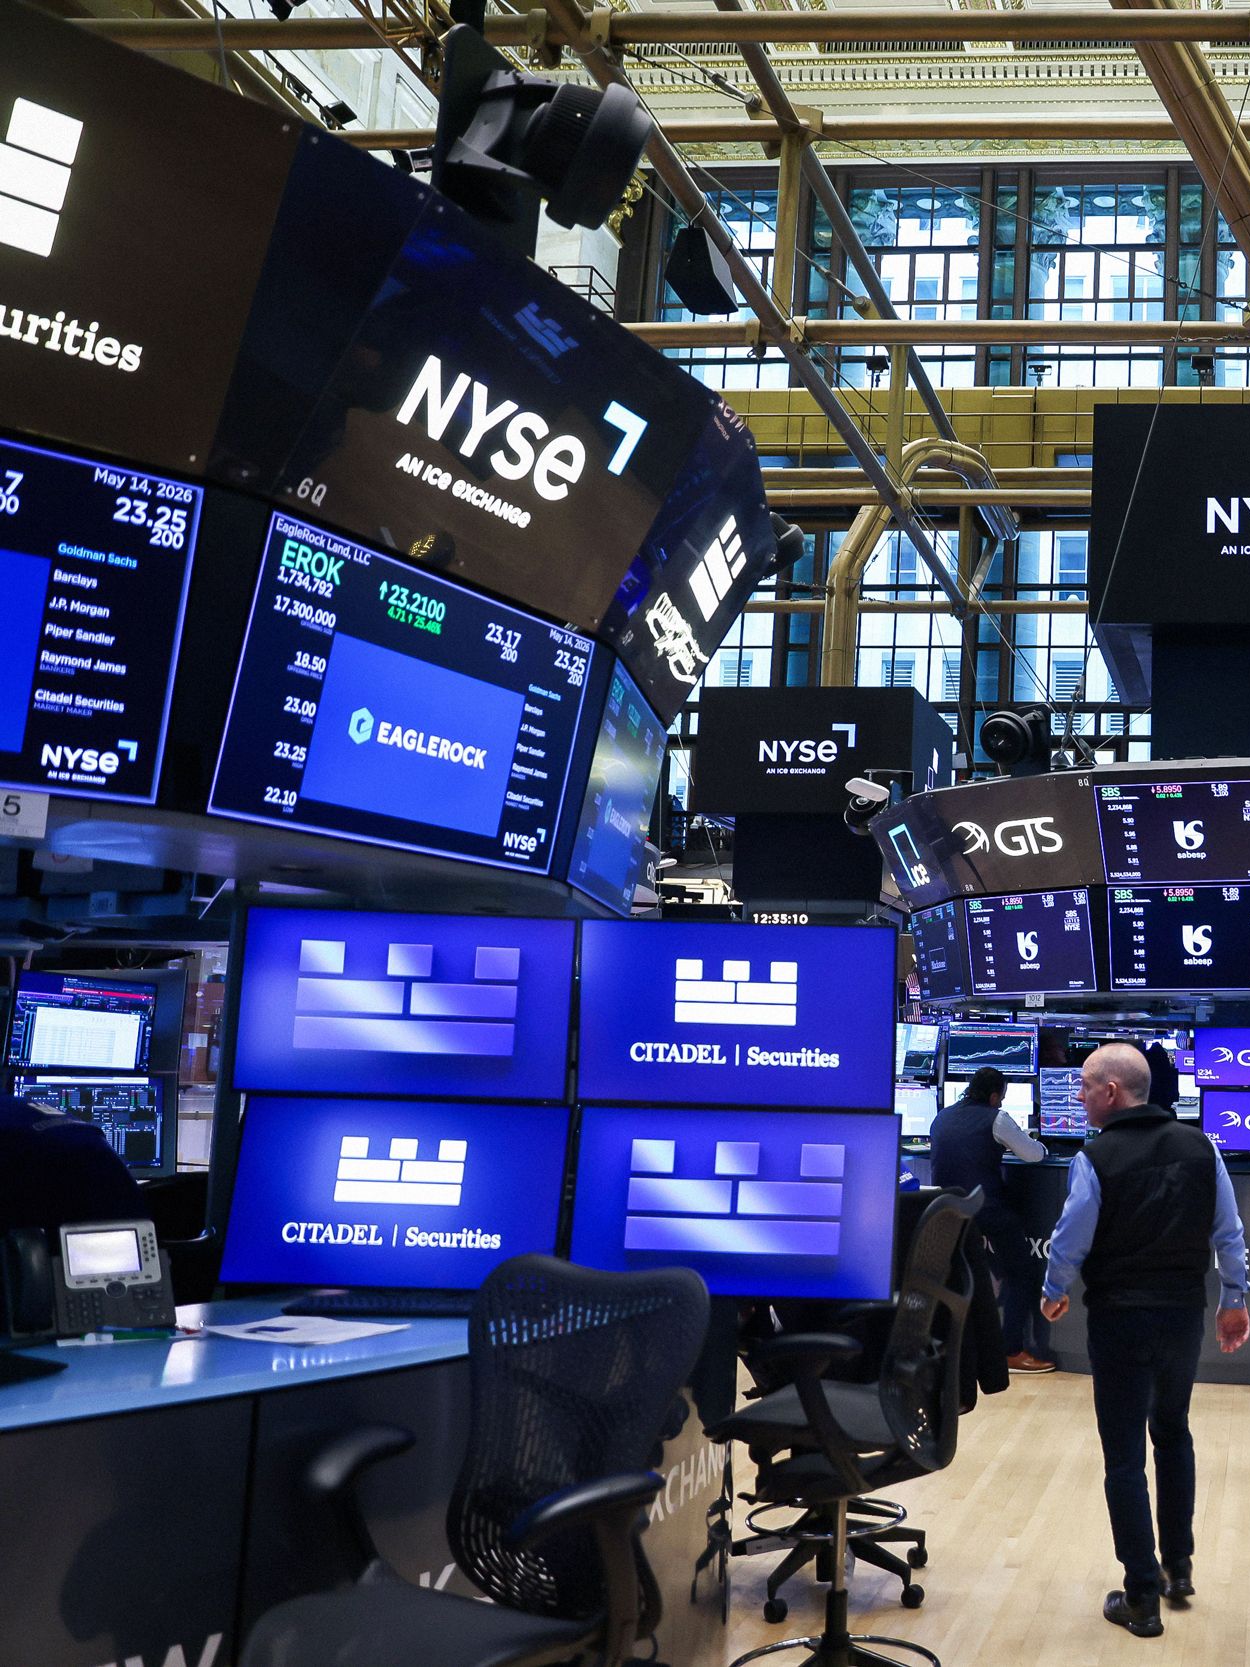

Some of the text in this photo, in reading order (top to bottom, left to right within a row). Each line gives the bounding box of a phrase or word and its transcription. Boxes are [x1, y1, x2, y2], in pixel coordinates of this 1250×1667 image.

[94, 467, 193, 503] May 14, 2026
[113, 496, 188, 533] 23.25
[149, 527, 185, 550] 200
[276, 517, 326, 546] EagleRock
[353, 548, 372, 566] LLC
[58, 542, 138, 569] Goldman Sachs
[1220, 545, 1238, 556] AN
[281, 539, 345, 586] EROK
[53, 568, 98, 589] Barclays
[277, 566, 334, 598] 1,734,792
[70, 600, 110, 618] Morgan
[273, 594, 337, 629] 17,300,000
[388, 584, 446, 622] 23.2100
[45, 622, 116, 647] Piper Sandler
[485, 622, 522, 649] 23.17
[549, 628, 563, 643] May
[41, 650, 127, 676] Raymond James
[294, 651, 327, 673] 18.50
[500, 646, 518, 663] 200
[554, 650, 586, 675] 23.25
[567, 672, 583, 687] 200
[34, 688, 125, 713] Citadel Securities
[284, 696, 316, 718] 23.00
[273, 741, 307, 762] 23.25
[377, 722, 488, 770] EAGLEROCK
[264, 786, 297, 807] 22.10
[1101, 787, 1120, 797] SBS
[1156, 785, 1183, 794] 5.8950
[1211, 784, 1229, 792] 5.89
[994, 816, 1064, 857] GTS
[1177, 851, 1207, 860] sabesp
[1114, 890, 1133, 899] SBS
[1168, 888, 1194, 897] 5.8950
[753, 913, 809, 925] 12:35:10
[1183, 957, 1213, 966] sabesp
[630, 1041, 840, 1069] CITADEL Securities
[282, 1221, 501, 1250] CITADEL Securities
